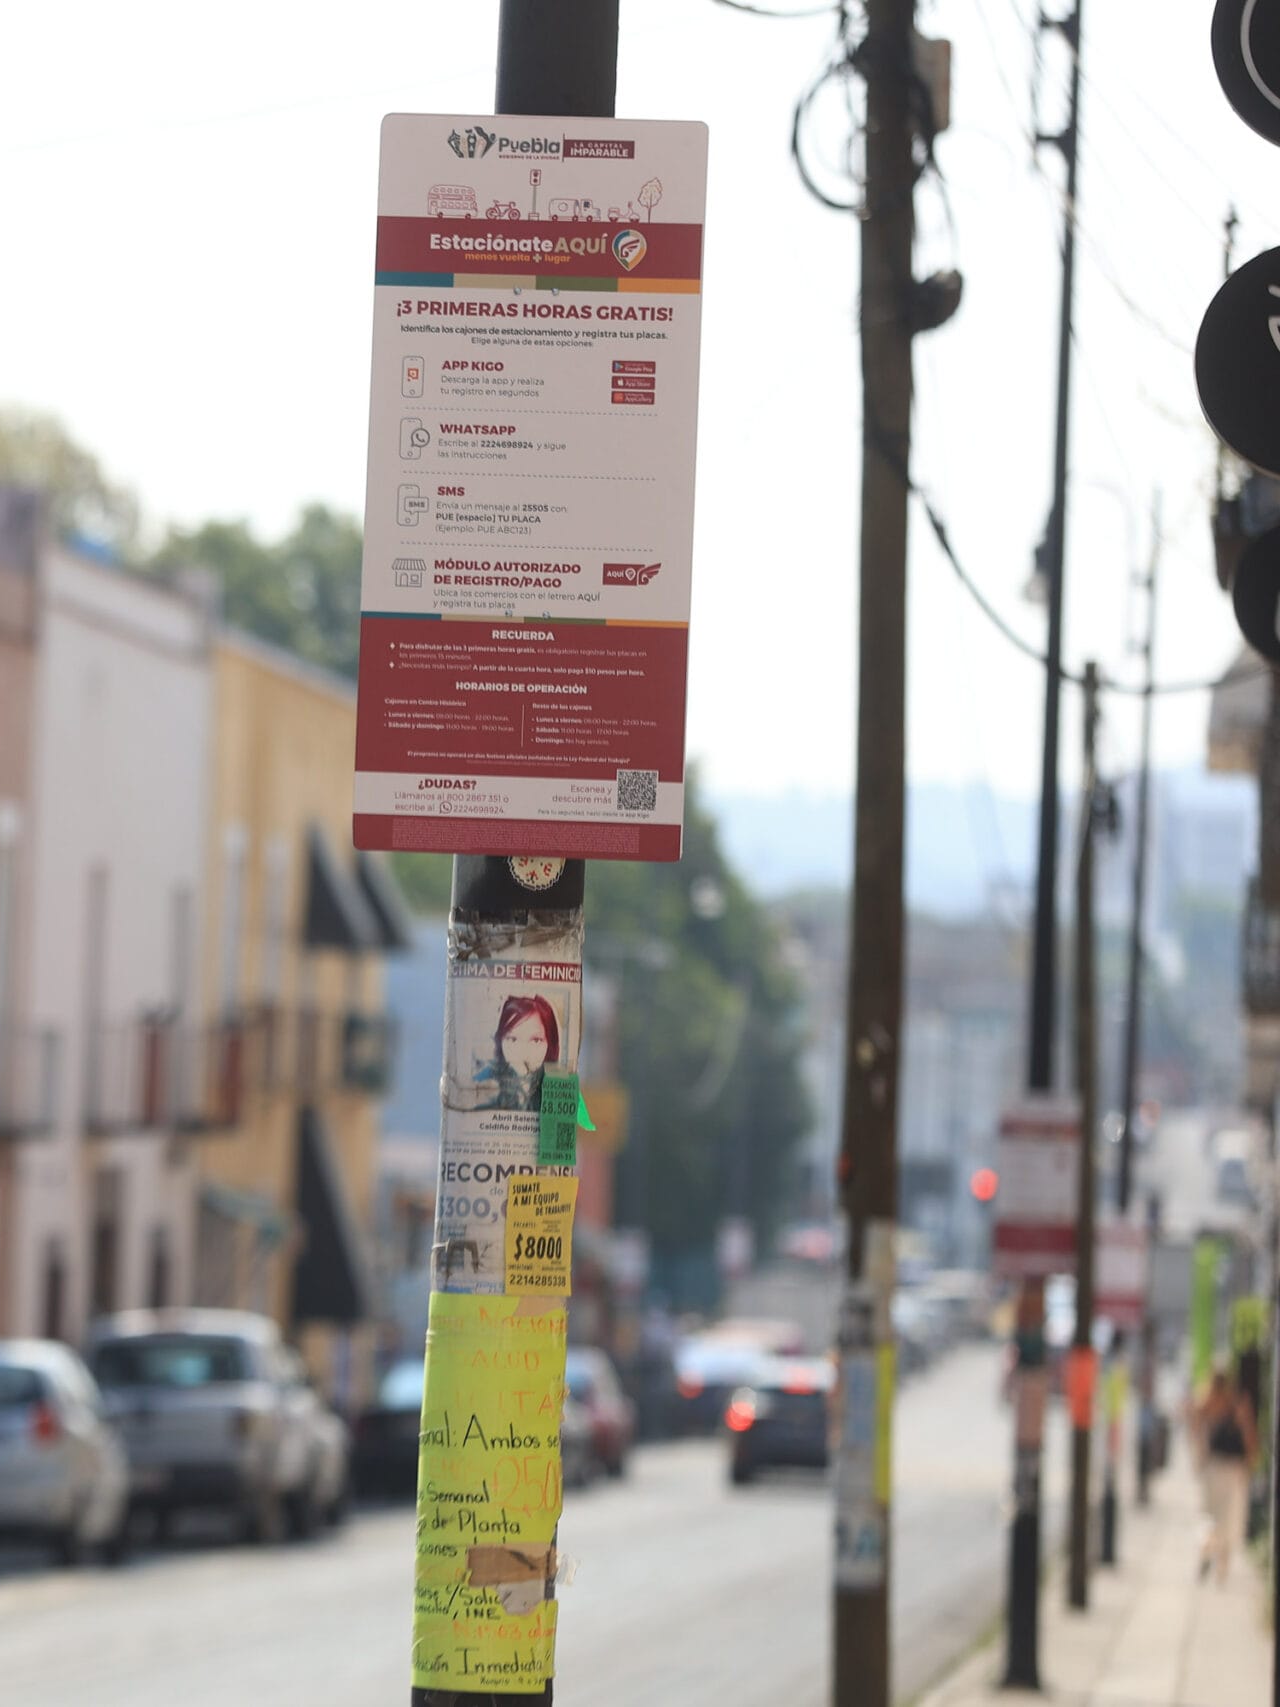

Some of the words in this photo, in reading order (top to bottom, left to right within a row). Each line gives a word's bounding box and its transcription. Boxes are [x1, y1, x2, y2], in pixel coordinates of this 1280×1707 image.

[499, 138, 560, 154] Puebla
[570, 147, 629, 158] IMPARABLE
[464, 252, 498, 261] menos
[499, 252, 530, 263] vuelta
[544, 253, 571, 265] lugar
[396, 301, 413, 317] ¡3
[417, 301, 519, 319] PRIMERAS
[522, 303, 593, 320] HORAS
[596, 305, 674, 322] GRATIS!
[400, 325, 441, 335] Identifica
[441, 326, 454, 334] los
[454, 327, 488, 337] cajones
[488, 327, 500, 335] de
[500, 328, 574, 338] estacionamiento
[581, 330, 618, 341] registra
[620, 331, 634, 340] tus
[636, 331, 669, 342] placas.
[471, 337, 491, 346] Elige
[493, 337, 521, 347] alguna
[522, 338, 532, 347] de
[533, 340, 554, 348] estas
[441, 359, 469, 371] APP
[471, 360, 505, 373] KIGO
[441, 374, 481, 386] Descarga
[482, 375, 490, 385] la
[491, 378, 510, 388] app
[517, 376, 545, 387] realiza
[440, 387, 450, 396] tu
[451, 386, 484, 398] registro
[498, 388, 540, 399] segundos
[439, 423, 517, 436] WHATSAPP
[438, 438, 469, 448] Escribe
[470, 438, 479, 448] al
[480, 439, 534, 450] 2224698924
[543, 441, 567, 452] sigue
[438, 449, 449, 458] las
[451, 450, 508, 461] instrucciones
[437, 486, 466, 497] SMS
[460, 502, 473, 511] un
[474, 502, 511, 513] mensaje
[511, 502, 521, 512] al
[522, 503, 549, 513] 25505
[550, 505, 567, 514] con
[435, 512, 455, 521] PUE
[455, 513, 497, 524] [espacio]
[497, 514, 511, 523] TU
[511, 514, 542, 524] PLACA
[476, 525, 495, 534] PUE
[496, 526, 532, 537] ABC123)
[433, 557, 491, 572] MÓDULO
[492, 560, 582, 575] AUTORIZADO
[605, 570, 624, 579] AQUÍ
[433, 574, 452, 586] DE
[453, 575, 563, 590] REGISTRO/PAGO
[433, 588, 459, 599] Ubica
[459, 589, 473, 599] los
[474, 590, 518, 601] comercios
[519, 592, 536, 601] con
[537, 591, 547, 601] el
[547, 591, 576, 602] letrero
[576, 591, 601, 604] AQUÍ
[439, 599, 472, 610] registra
[473, 600, 487, 610] tus
[488, 600, 516, 611] placas
[491, 629, 556, 642] RECUERDA
[455, 680, 510, 694] HORARIOS
[511, 682, 526, 693] DE
[526, 683, 588, 696] OPERACIÓN
[418, 777, 478, 790] ¿DUDAS?
[570, 783, 606, 793] Escanea
[394, 791, 436, 802] Llámanos
[437, 792, 445, 802] al
[446, 793, 465, 802] 800
[502, 796, 510, 804] o
[552, 793, 593, 804] descubre
[593, 795, 613, 805] más
[394, 802, 426, 812] escribe
[427, 803, 436, 812] al
[493, 963, 517, 978] DE
[491, 1112, 513, 1123] Abril
[512, 1182, 542, 1194] SUMATE
[512, 1196, 519, 1207] A
[520, 1195, 532, 1206] MI
[533, 1192, 560, 1206] EQUIPO
[535, 1206, 544, 1216] DE
[513, 1232, 563, 1262] $8000
[462, 1413, 542, 1451] Ambos
[426, 1479, 491, 1504] Semanal
[457, 1506, 522, 1535] Planta
[465, 1607, 501, 1621] INE
